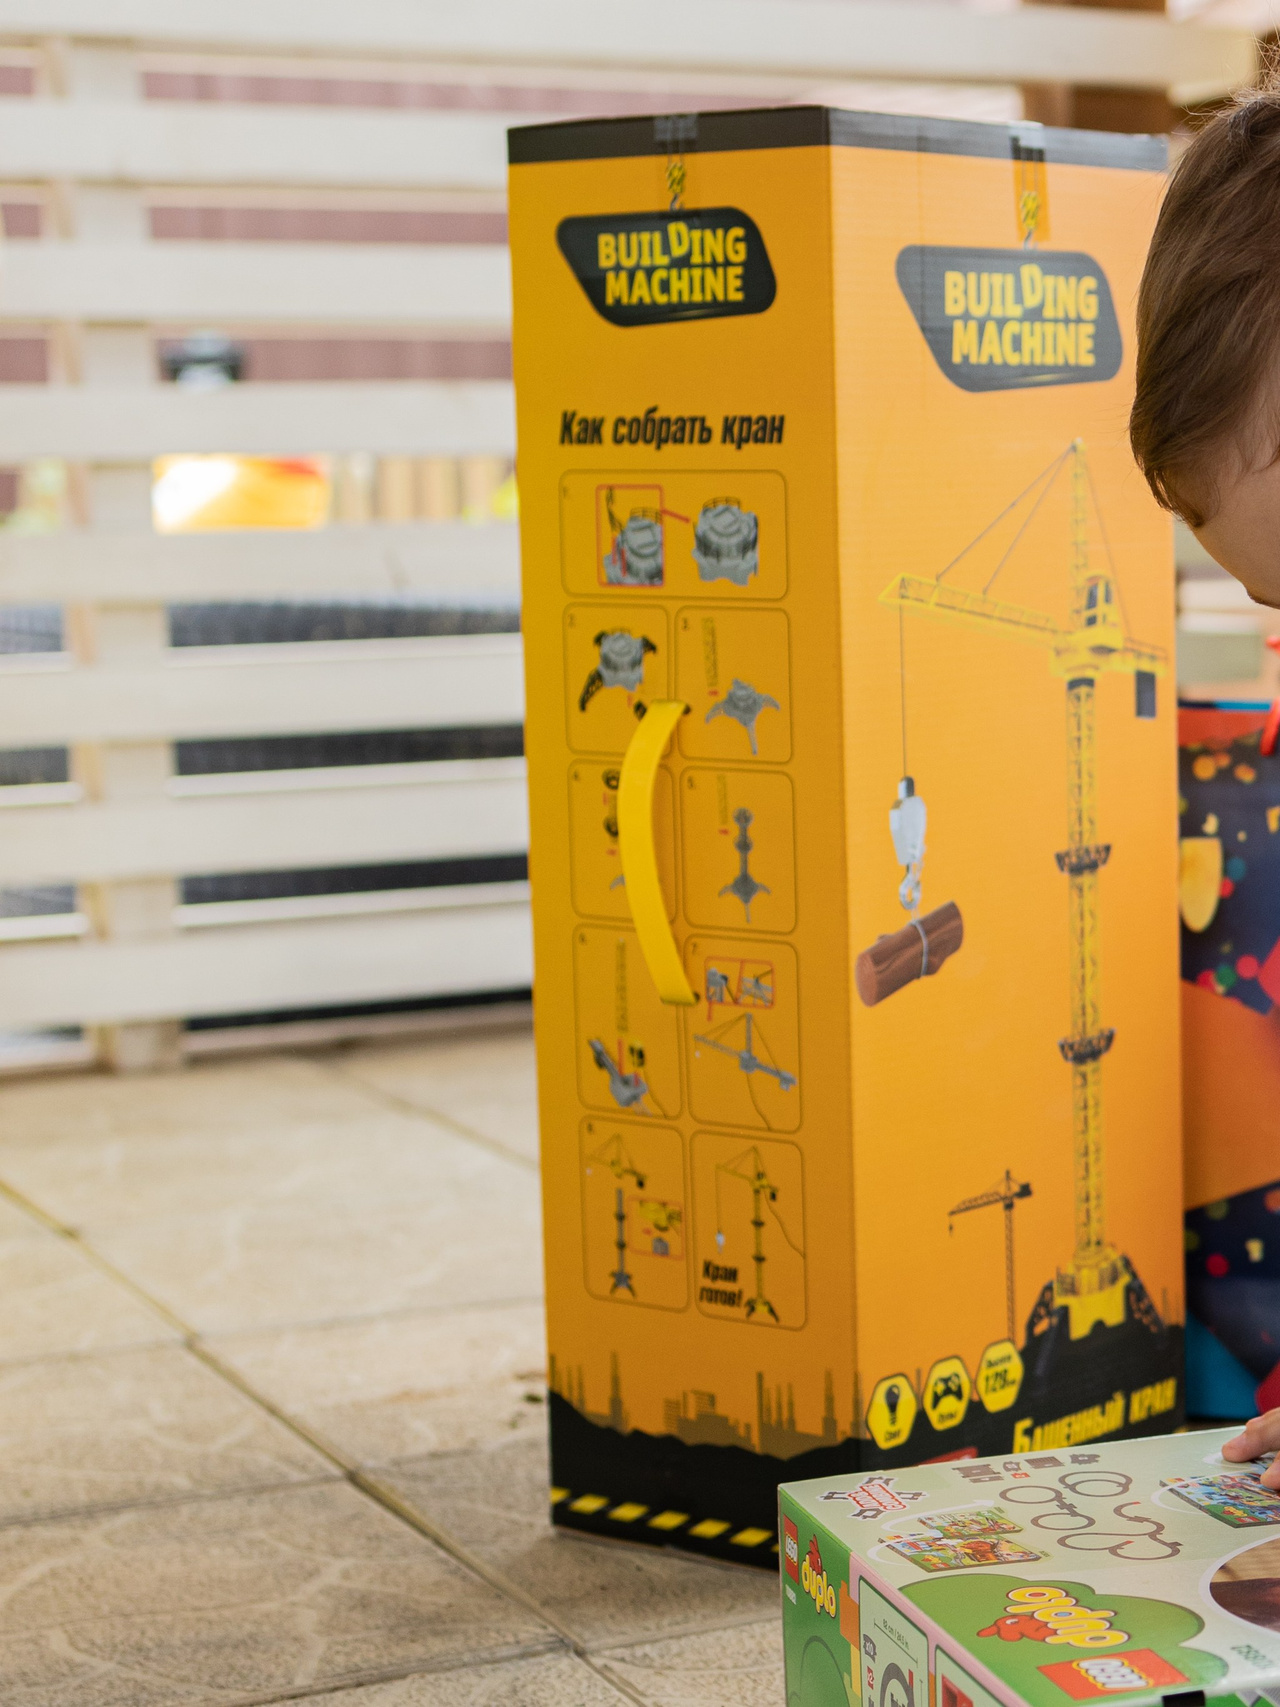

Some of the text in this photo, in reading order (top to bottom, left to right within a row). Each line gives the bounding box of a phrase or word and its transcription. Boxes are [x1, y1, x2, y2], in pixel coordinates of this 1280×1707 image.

[597, 221, 747, 269] BUILDING
[605, 266, 744, 306] MACHINE
[944, 264, 1099, 321] BUILDING
[952, 319, 1096, 367] MACHINE
[560, 406, 784, 450] Как собрать кран
[703, 1259, 739, 1283] Кран
[801, 1552, 837, 1619] duplo
[1004, 1585, 1132, 1648] duplo
[1073, 1656, 1152, 1690] LEGO
